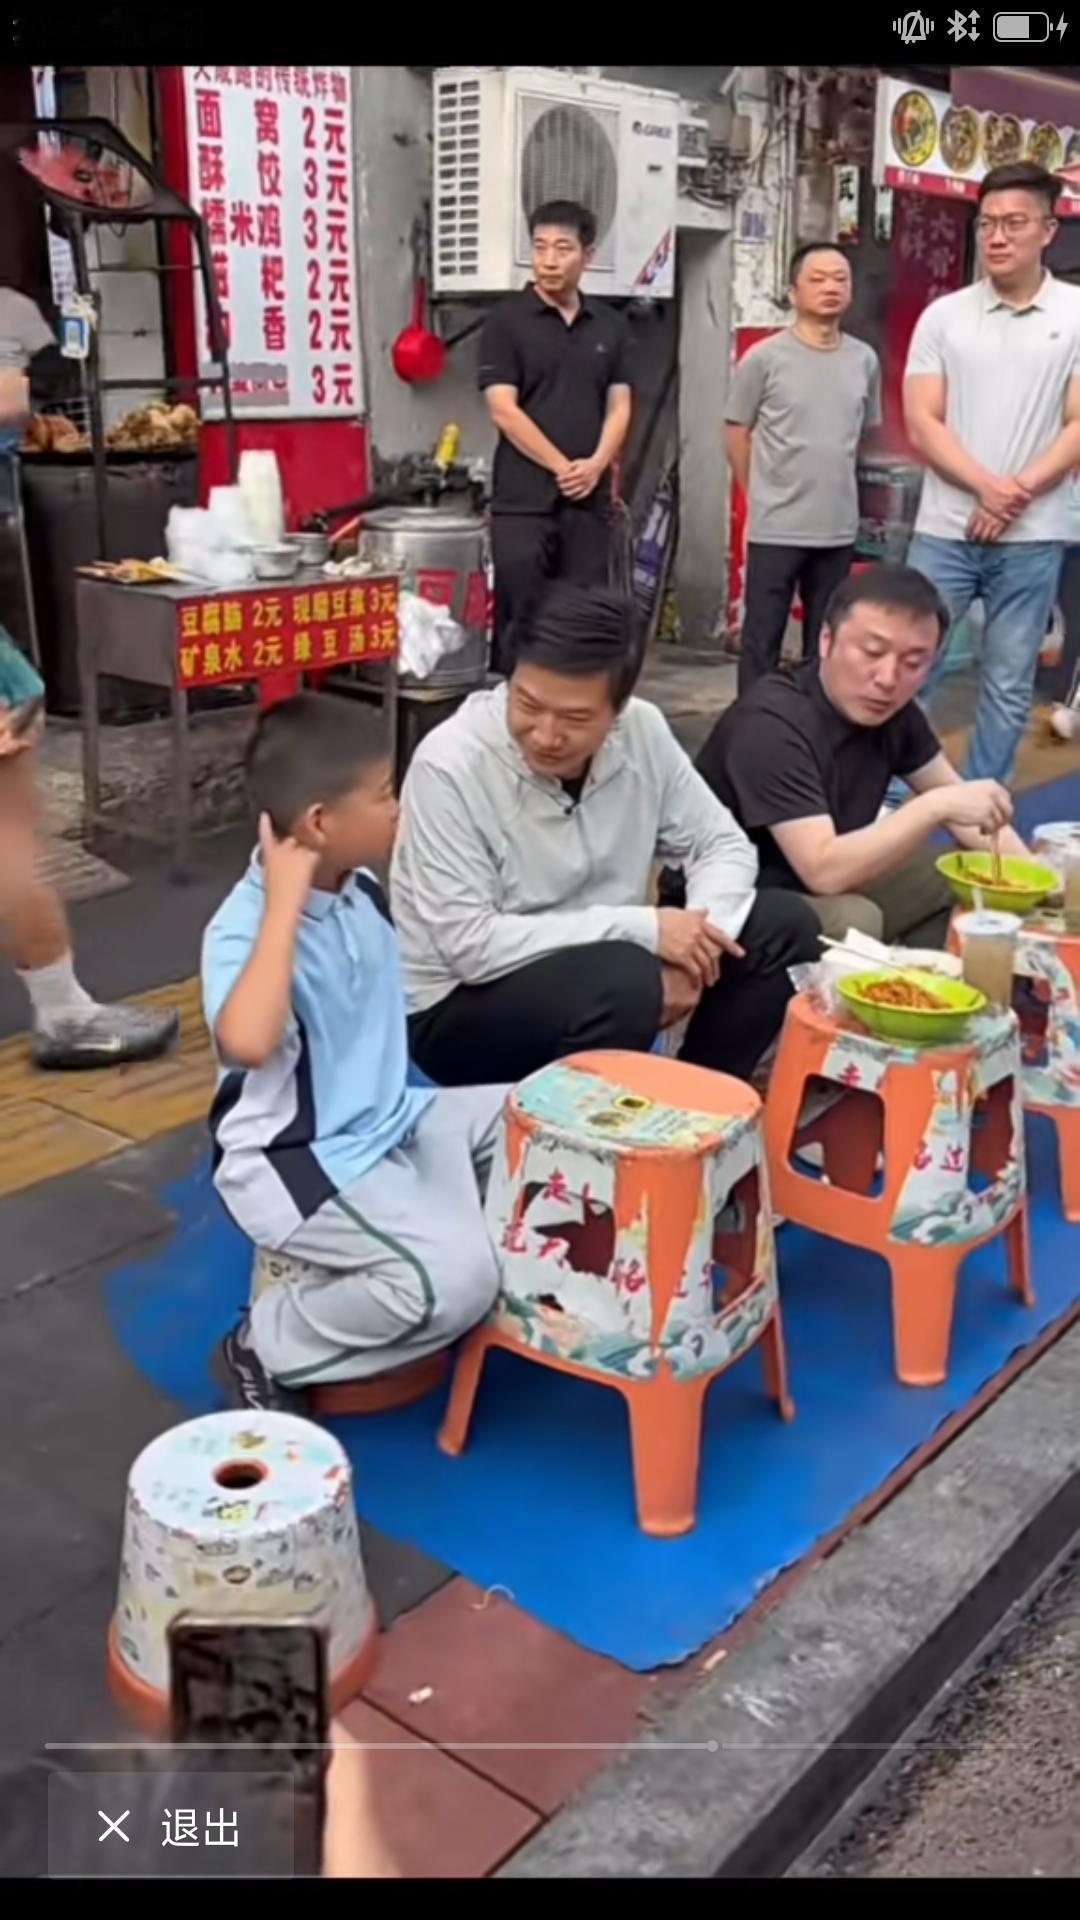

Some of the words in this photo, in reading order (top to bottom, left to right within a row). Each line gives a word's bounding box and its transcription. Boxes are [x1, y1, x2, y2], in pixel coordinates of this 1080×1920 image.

[195, 89, 278, 146] 面窝
[302, 106, 346, 154] 2元
[303, 157, 348, 205] 3元
[303, 208, 348, 253] 3元
[307, 258, 350, 302] 2元
[309, 309, 352, 351] 2元
[252, 597, 284, 629] 2元
[180, 640, 243, 678] 矿泉水
[252, 636, 284, 667] 2元
